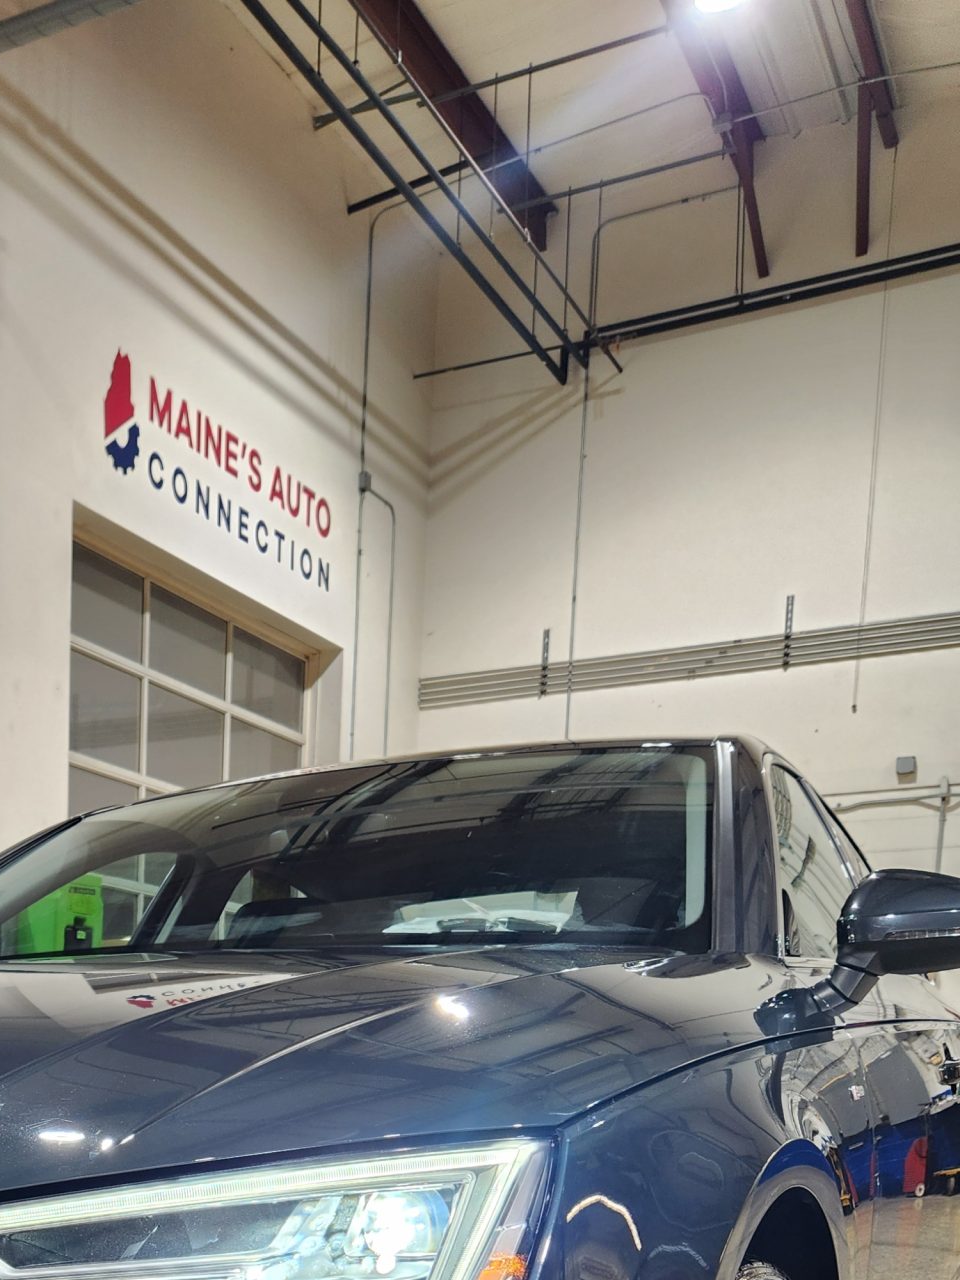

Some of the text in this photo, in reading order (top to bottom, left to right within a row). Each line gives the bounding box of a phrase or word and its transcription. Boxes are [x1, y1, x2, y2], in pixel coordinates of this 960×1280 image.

[148, 451, 330, 592] CONNECTION
[149, 376, 331, 538] MAINE'S AUTO
